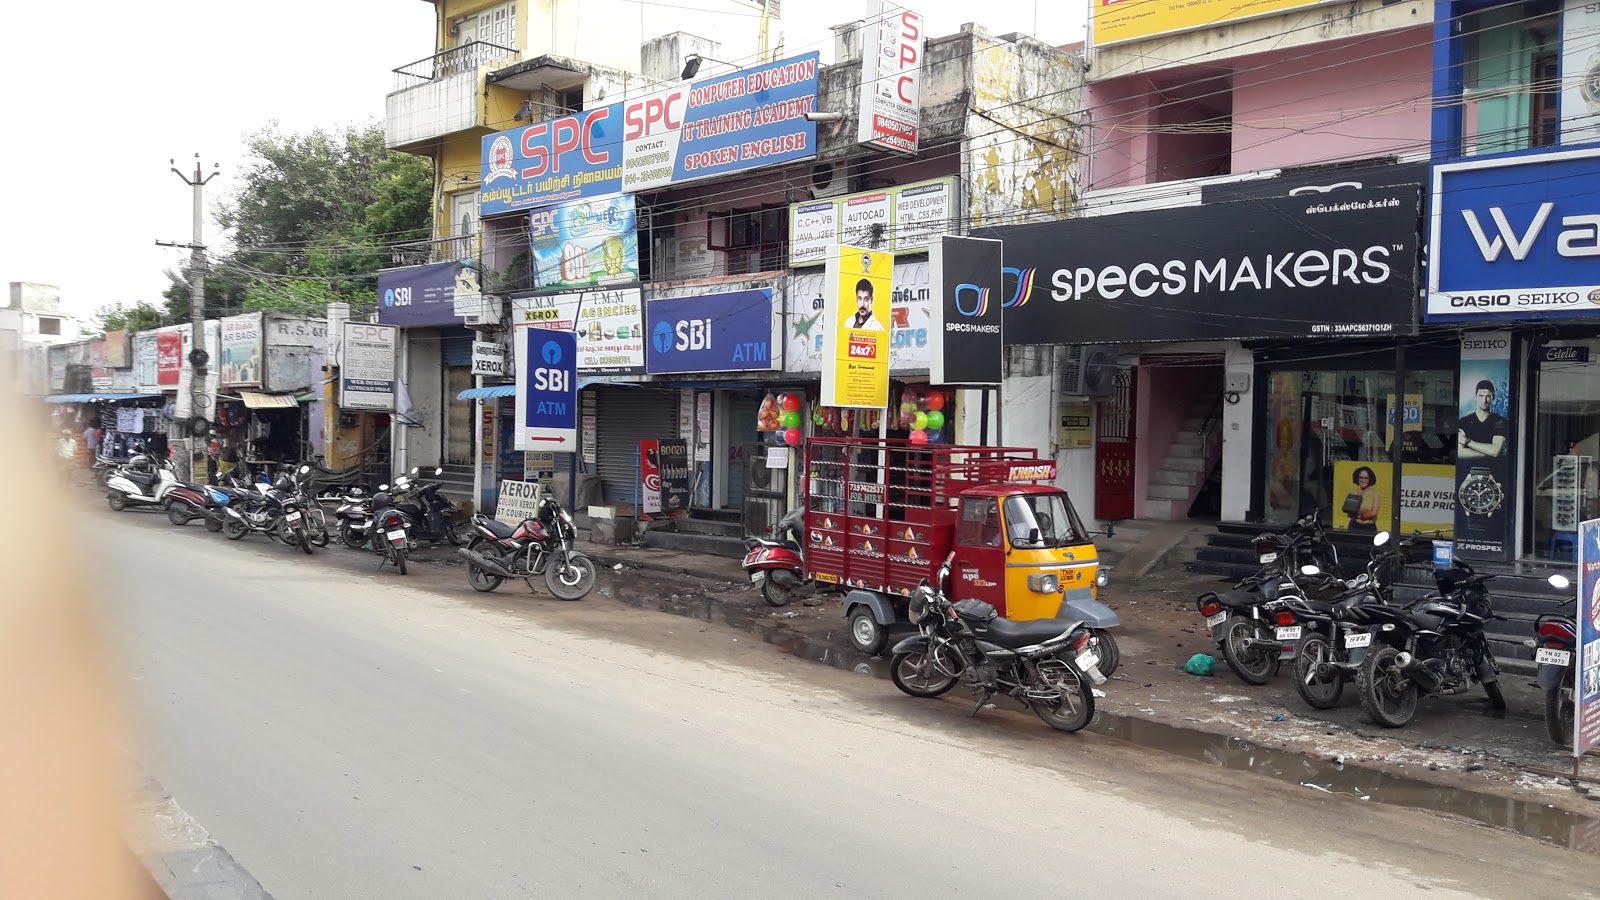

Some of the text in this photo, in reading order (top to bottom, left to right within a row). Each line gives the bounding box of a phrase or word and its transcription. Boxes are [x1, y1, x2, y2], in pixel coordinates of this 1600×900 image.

[897, 11, 918, 104] SPC
[688, 58, 815, 108] COMPUTER EDUCATION
[625, 92, 681, 141] SPC
[682, 94, 814, 142] IT TRAINING ACADEMY
[521, 107, 609, 179] SPC
[684, 132, 806, 171] SPOKEN ENGLISH
[535, 173, 570, 192] பயிற்சி
[572, 164, 623, 188] நிலையம்
[923, 185, 943, 193] COURSES
[867, 194, 886, 202] COURSES
[898, 195, 948, 211] WEB DEVELOPMENT
[815, 202, 833, 211] COURSES
[531, 209, 559, 237] SPC
[847, 209, 885, 222] AUTOCAD
[394, 286, 412, 307] SBI
[1450, 294, 1511, 308] CASIO
[1517, 291, 1580, 306] SEIKO
[525, 309, 559, 321] XEROX
[581, 304, 638, 319] AGENCIES
[235, 330, 258, 341] BAGS
[352, 326, 388, 341] SPC
[675, 318, 712, 352] SBI
[1311, 324, 1330, 333] GSTIN
[732, 342, 767, 362] ATM
[850, 345, 871, 356] 24x7
[1463, 340, 1507, 350] SEIKO
[1546, 346, 1578, 361] Estelle
[475, 359, 503, 373] XEROX
[534, 367, 569, 393] SBI
[536, 401, 566, 416] ATM
[500, 481, 538, 500] XEROX
[850, 491, 882, 503] FOR HIRE
[1400, 489, 1430, 499] CLEAR
[519, 500, 536, 510] XEROX
[1400, 499, 1430, 509] CLEAR
[496, 507, 533, 519] ST COURIER
[1465, 543, 1502, 552] PROSPEX
